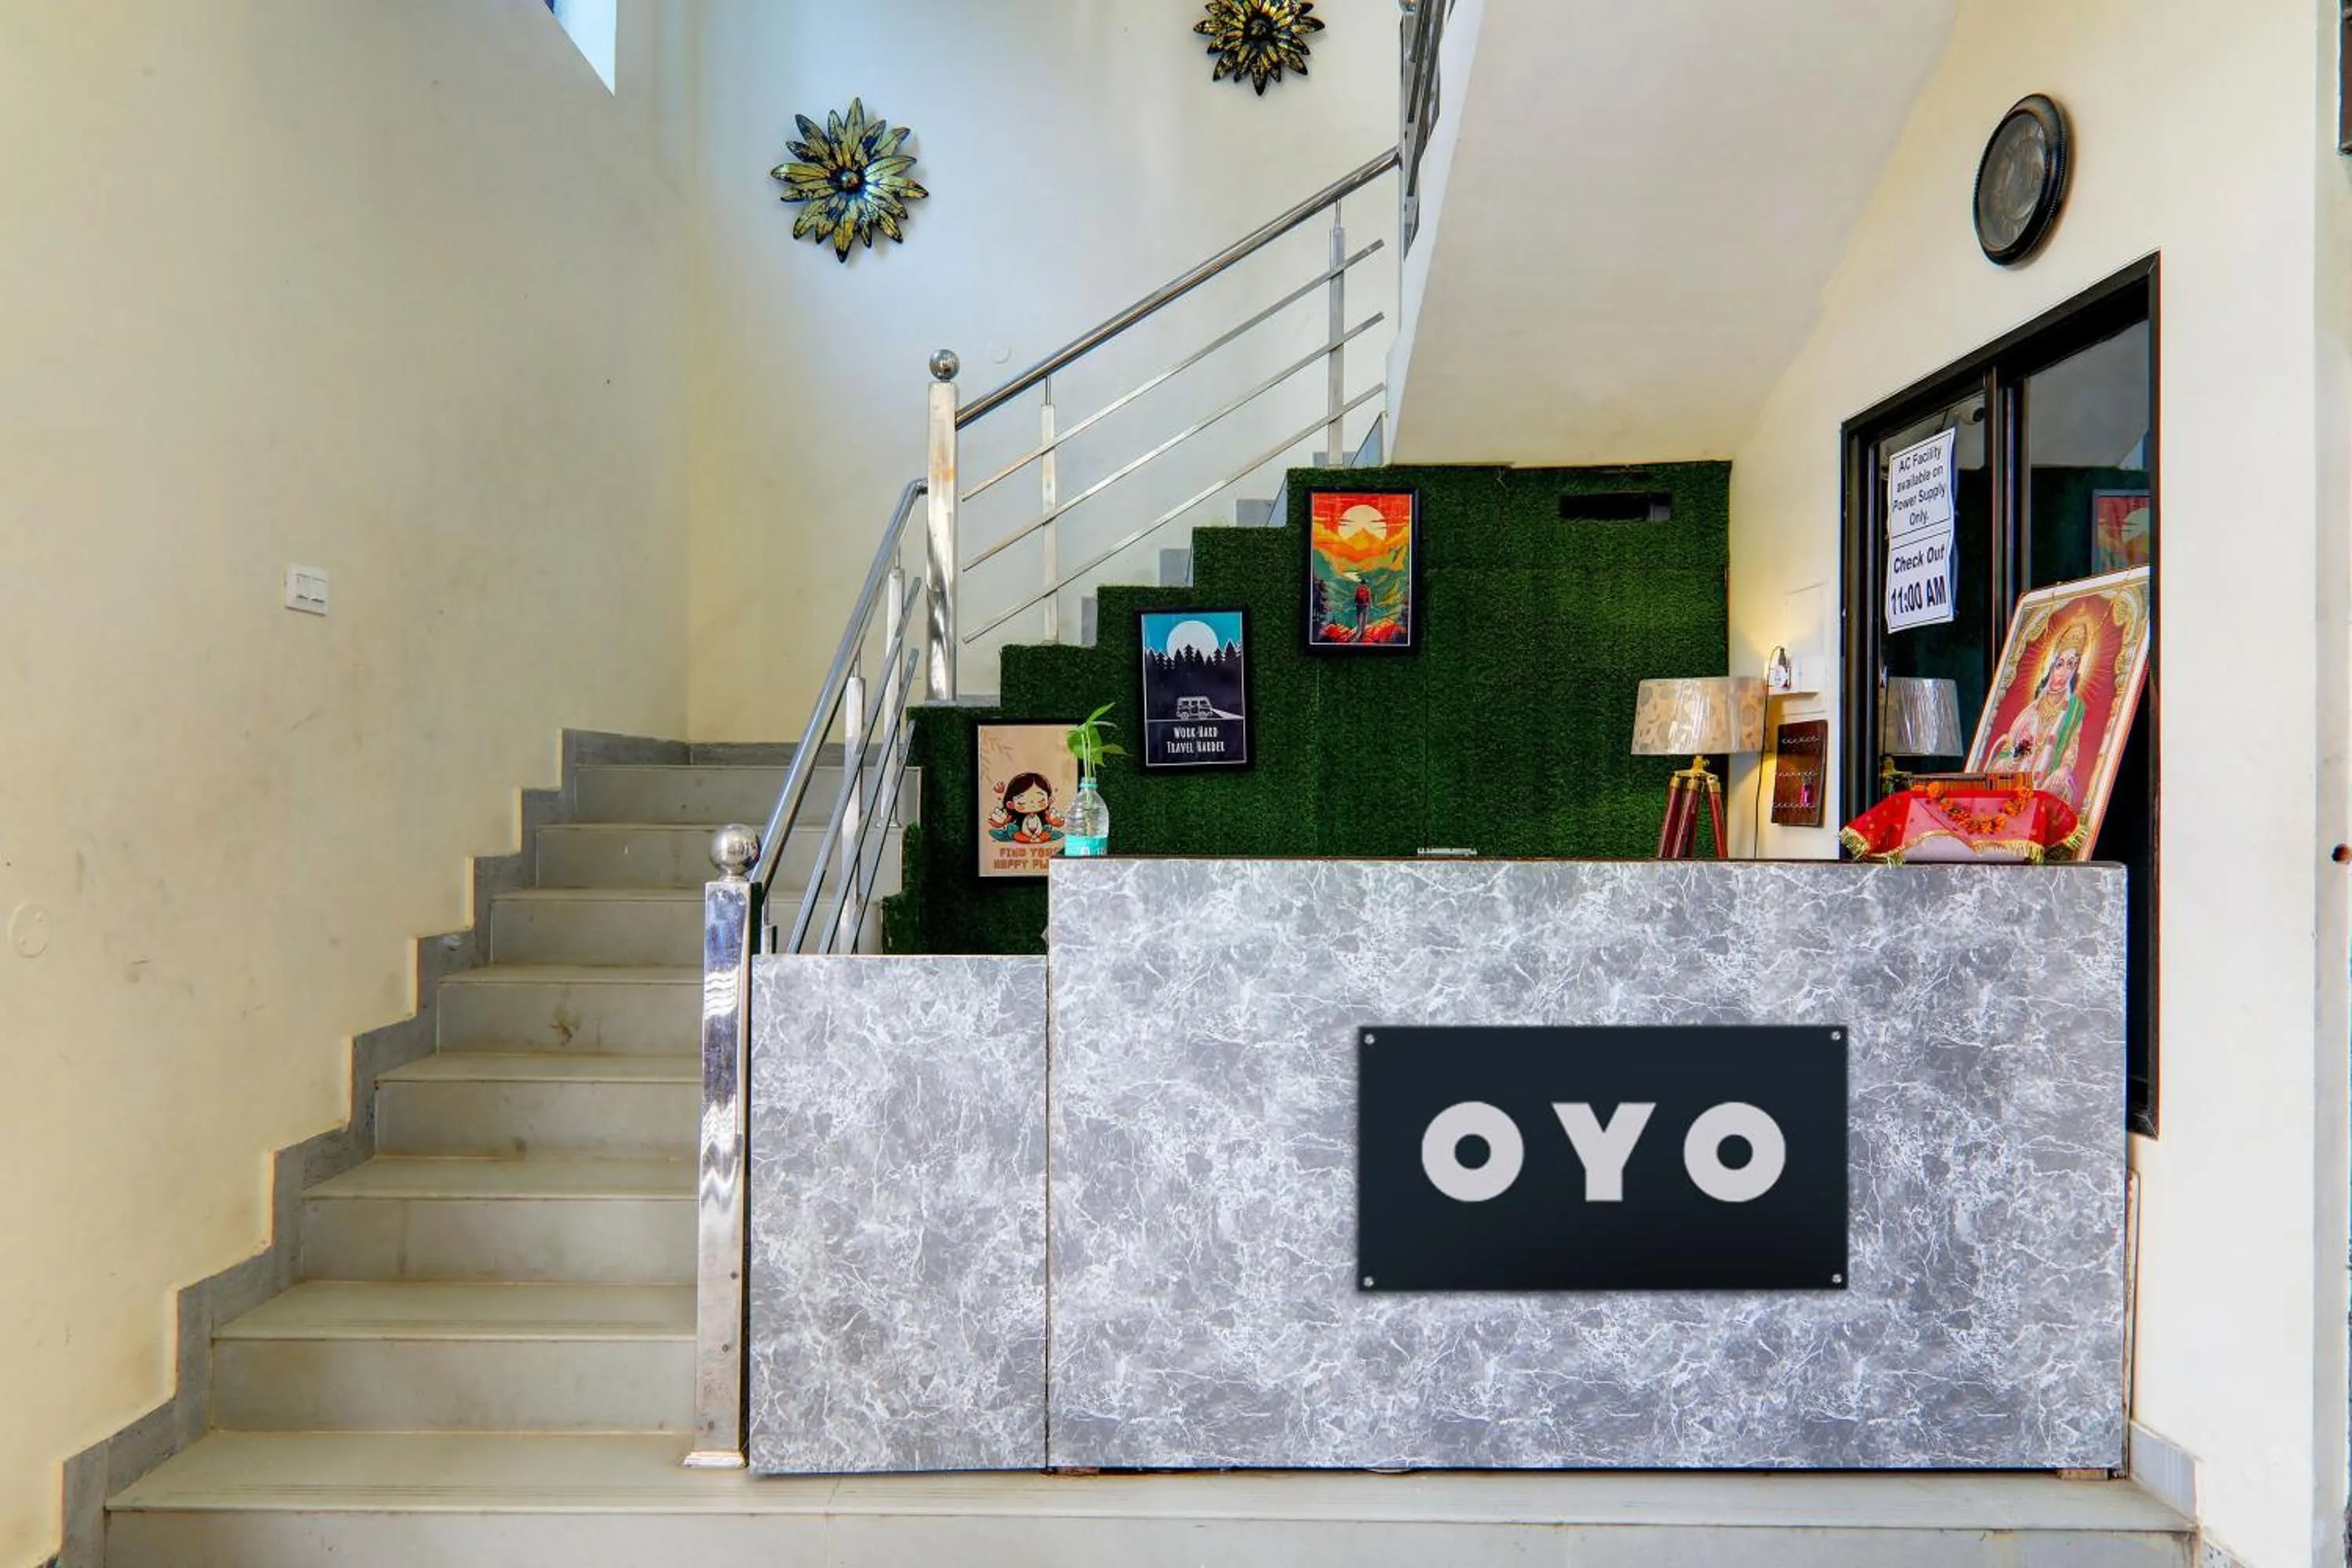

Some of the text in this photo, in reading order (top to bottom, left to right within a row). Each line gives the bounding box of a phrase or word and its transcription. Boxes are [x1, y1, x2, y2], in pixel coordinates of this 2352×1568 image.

[1899, 445, 1941, 474] AC Facility
[1897, 465, 1944, 492] available on
[1893, 482, 1945, 513] Power Supply
[1893, 544, 1945, 574] Check Out
[1891, 575, 1947, 615] 11:00 AM
[1174, 725, 1218, 738] WORK HARD
[1167, 741, 1225, 753] TRAVEL HARDER
[993, 858, 1029, 869] HAPPY
[1000, 848, 1026, 858] FIND
[1421, 1101, 1786, 1203] OYO
